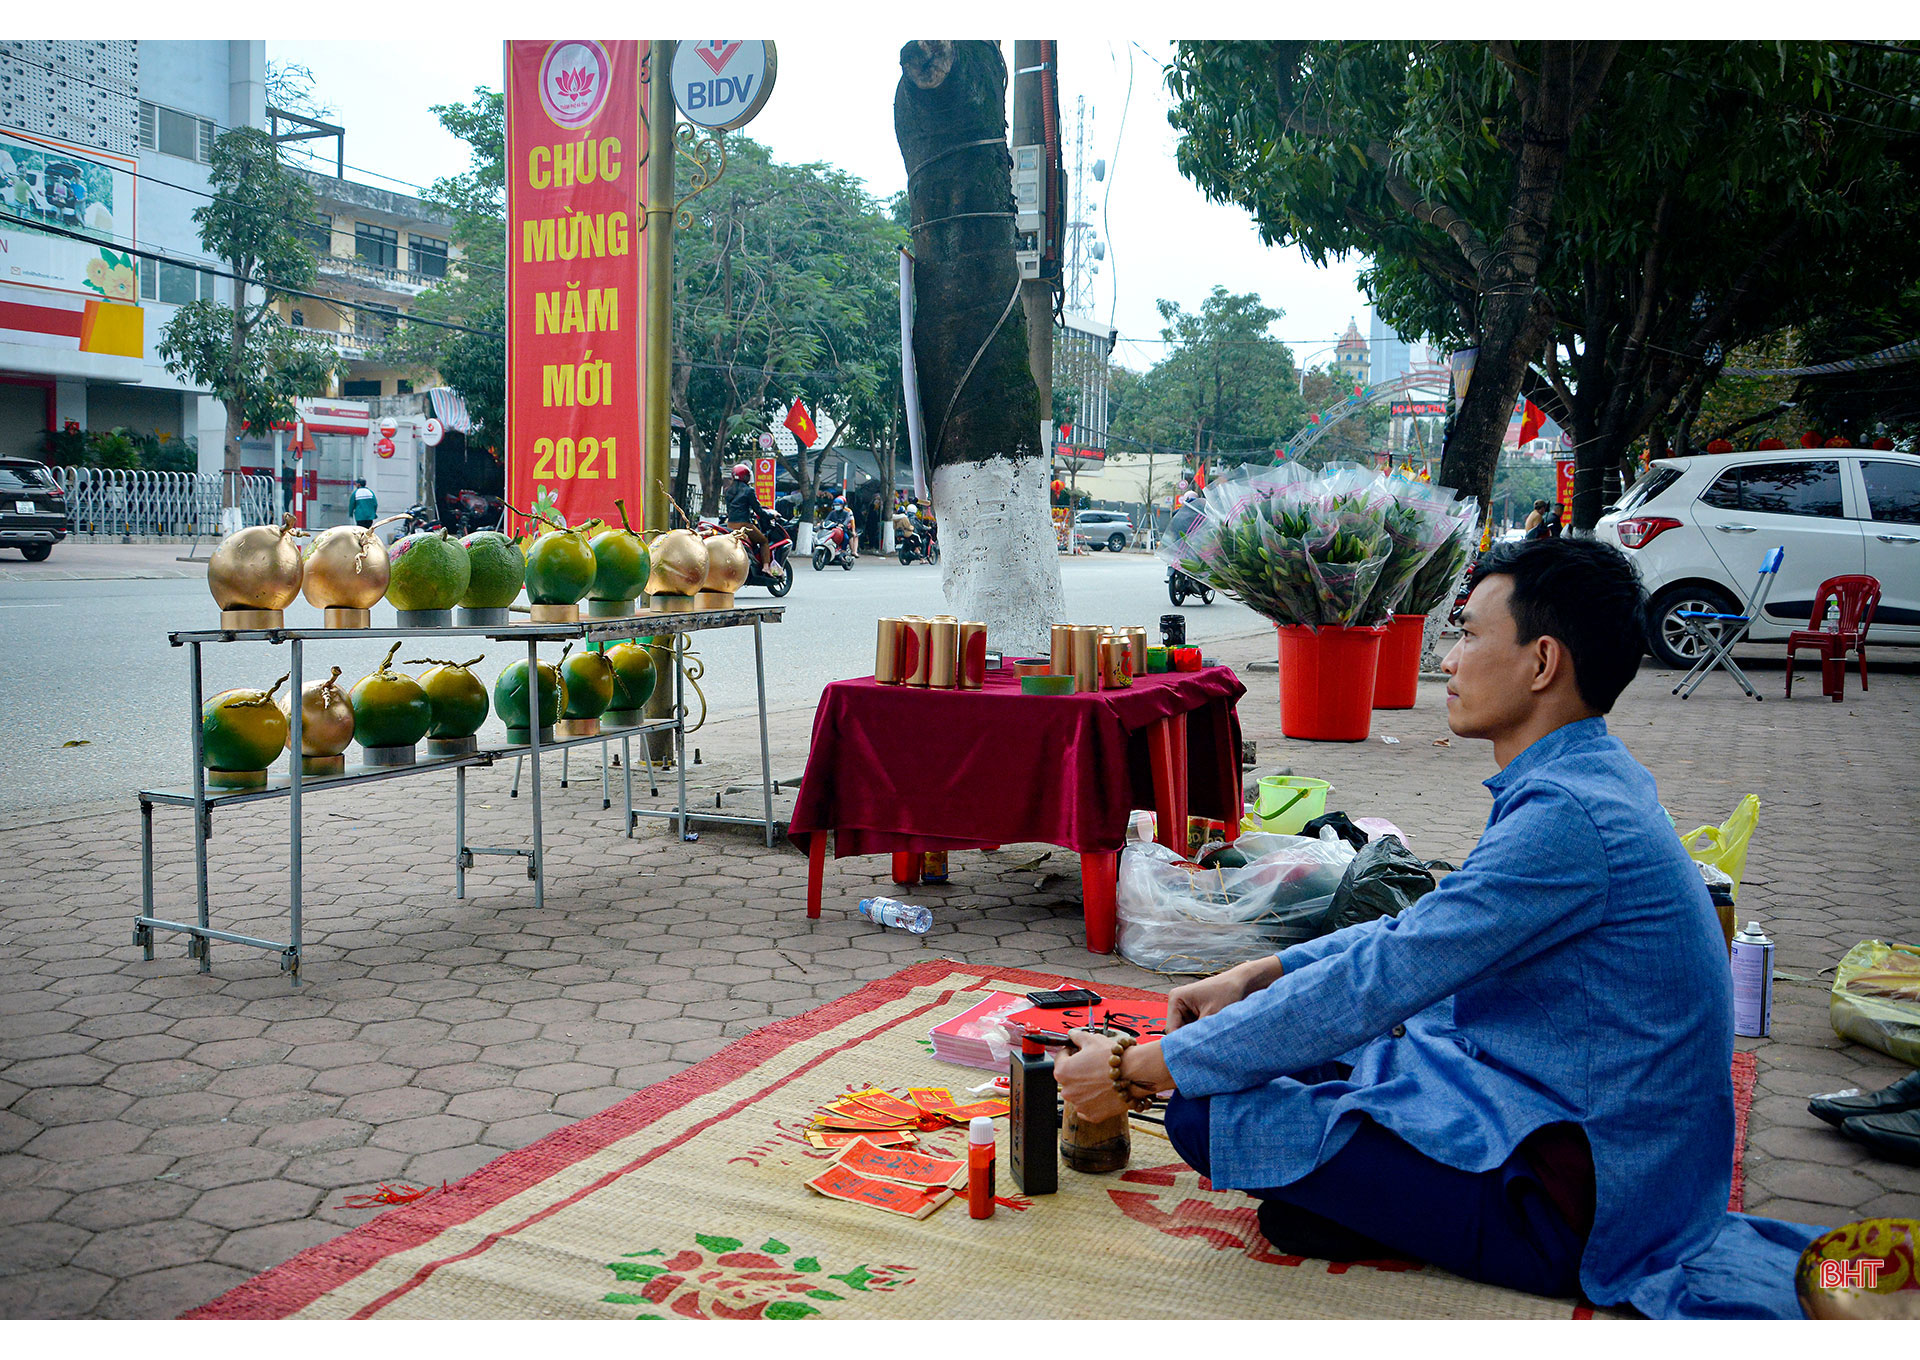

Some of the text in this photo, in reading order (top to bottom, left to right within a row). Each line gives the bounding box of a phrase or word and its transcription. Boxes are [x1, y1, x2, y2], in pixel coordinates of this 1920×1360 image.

[687, 73, 754, 111] BIDV
[528, 130, 622, 190] CHÚC
[523, 205, 629, 263] MỪNG
[535, 280, 619, 335] NĂM
[543, 350, 612, 407] MỚI
[532, 436, 617, 480] 2021
